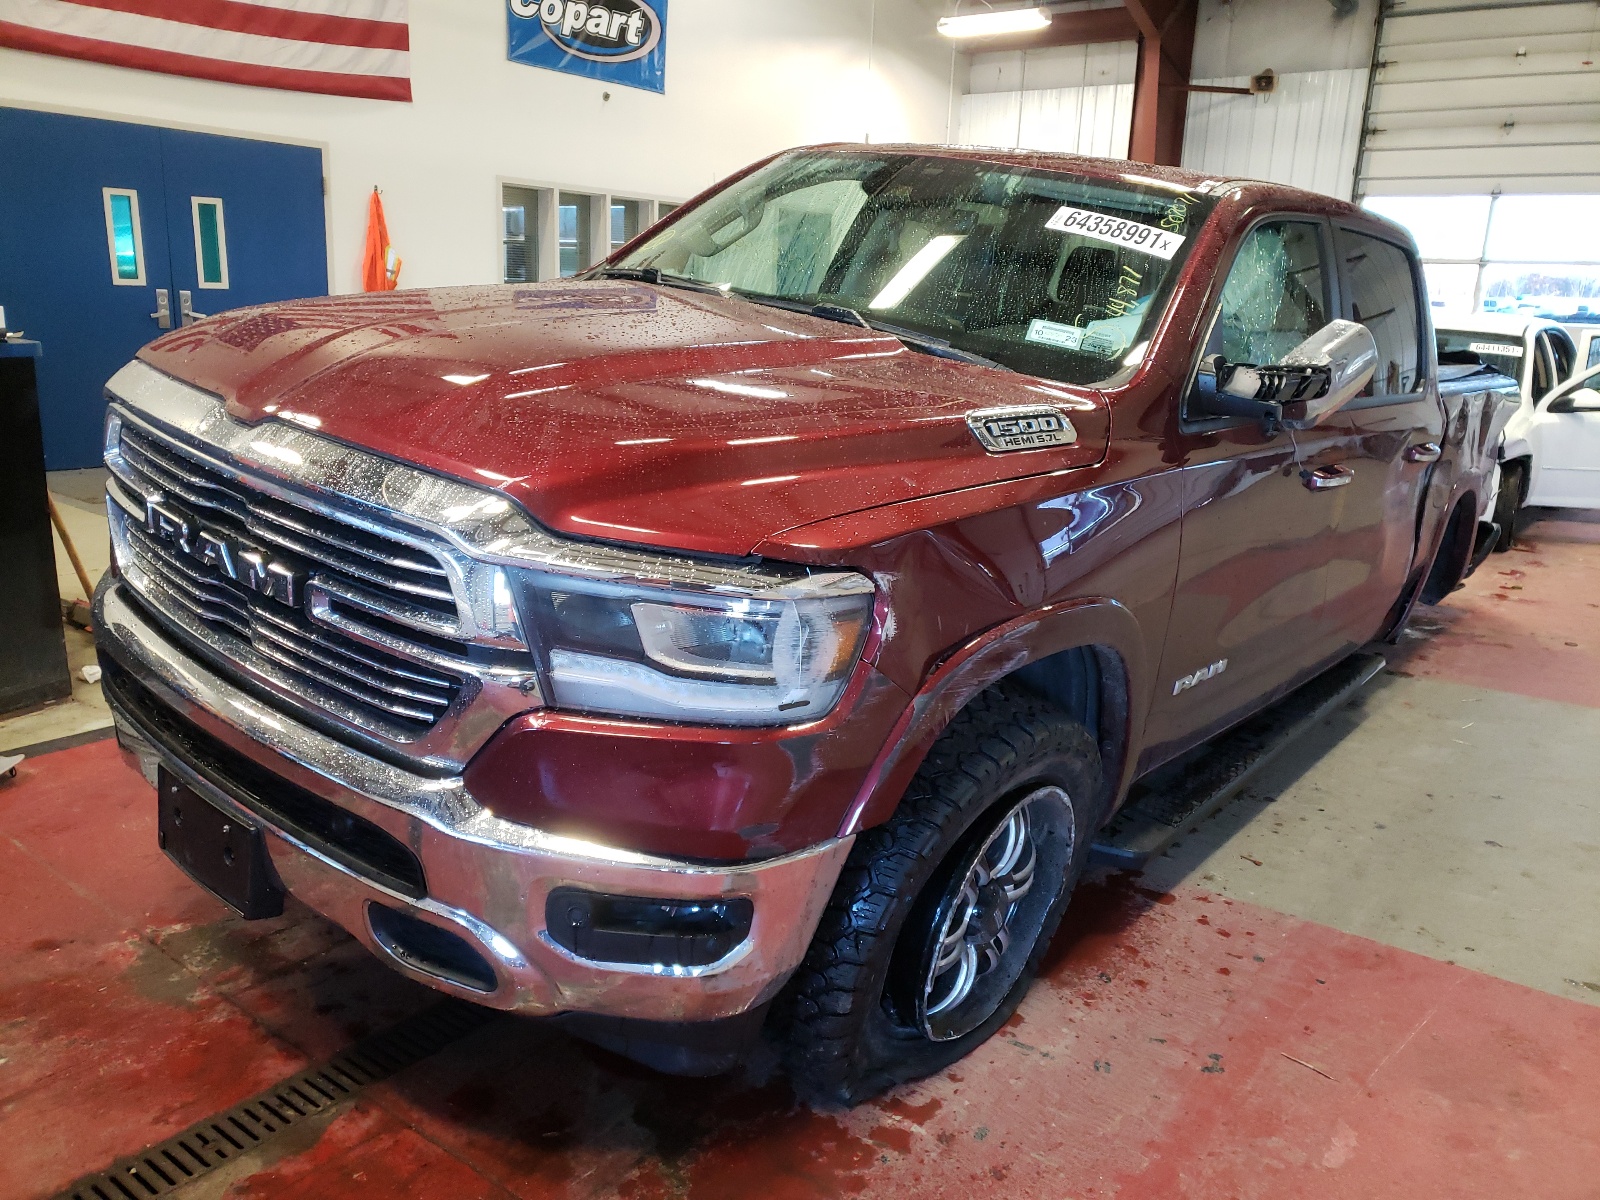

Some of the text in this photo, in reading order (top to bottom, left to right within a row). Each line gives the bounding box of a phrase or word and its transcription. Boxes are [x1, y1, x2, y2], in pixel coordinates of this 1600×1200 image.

[985, 417, 1059, 437] 1500
[1003, 434, 1062, 447] HEMI 5.7L
[147, 500, 296, 608] RAM
[1171, 659, 1228, 696] RAM
